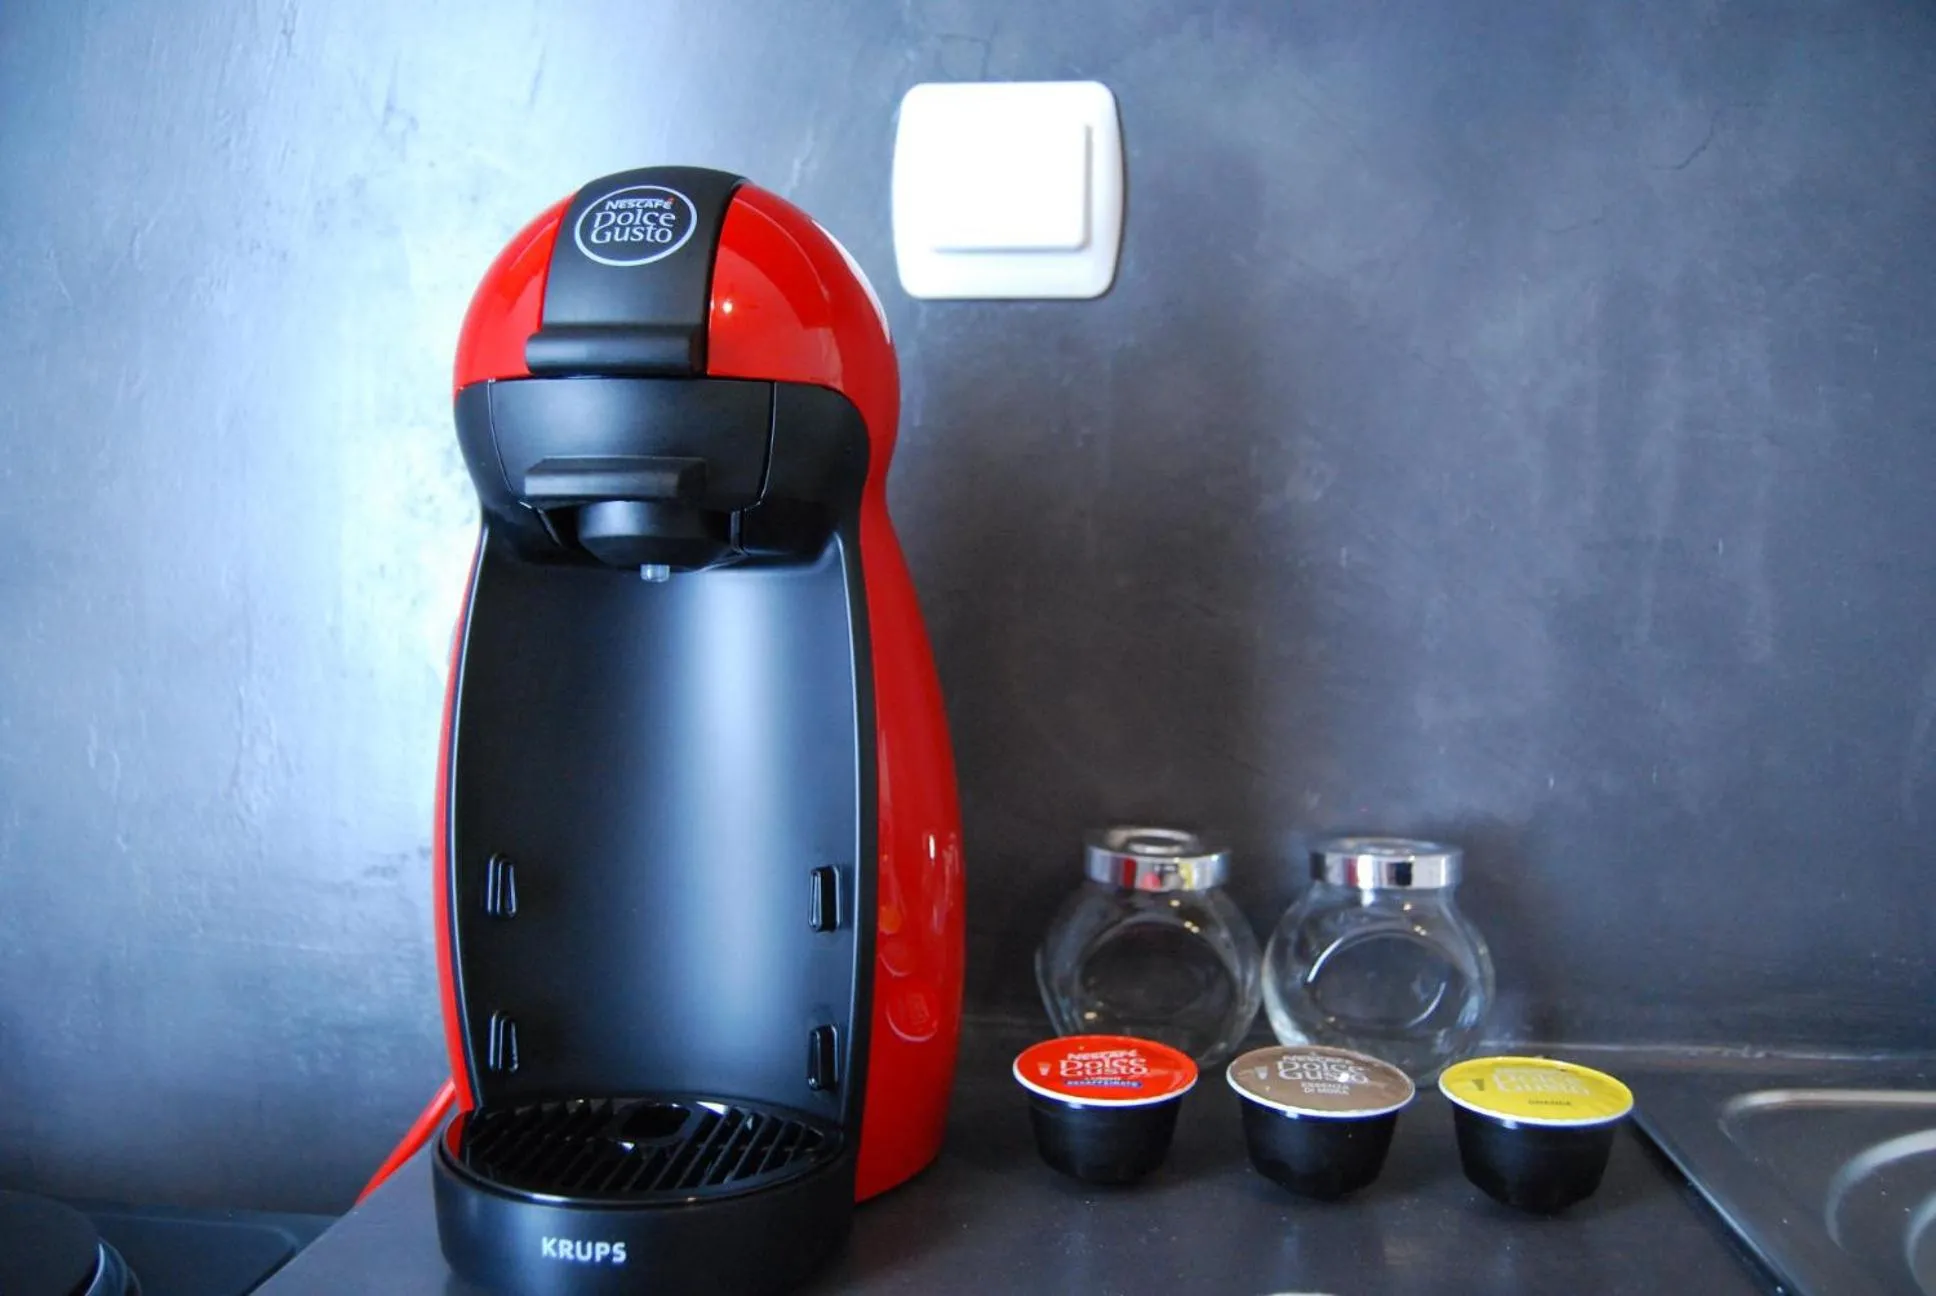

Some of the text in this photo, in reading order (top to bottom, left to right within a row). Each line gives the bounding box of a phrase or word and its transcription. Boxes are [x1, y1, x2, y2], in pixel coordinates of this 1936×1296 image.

[604, 197, 675, 211] NESCAFÉ
[593, 209, 676, 228] Dolce
[590, 225, 673, 244] Gusto
[541, 1236, 627, 1264] KRUPS
